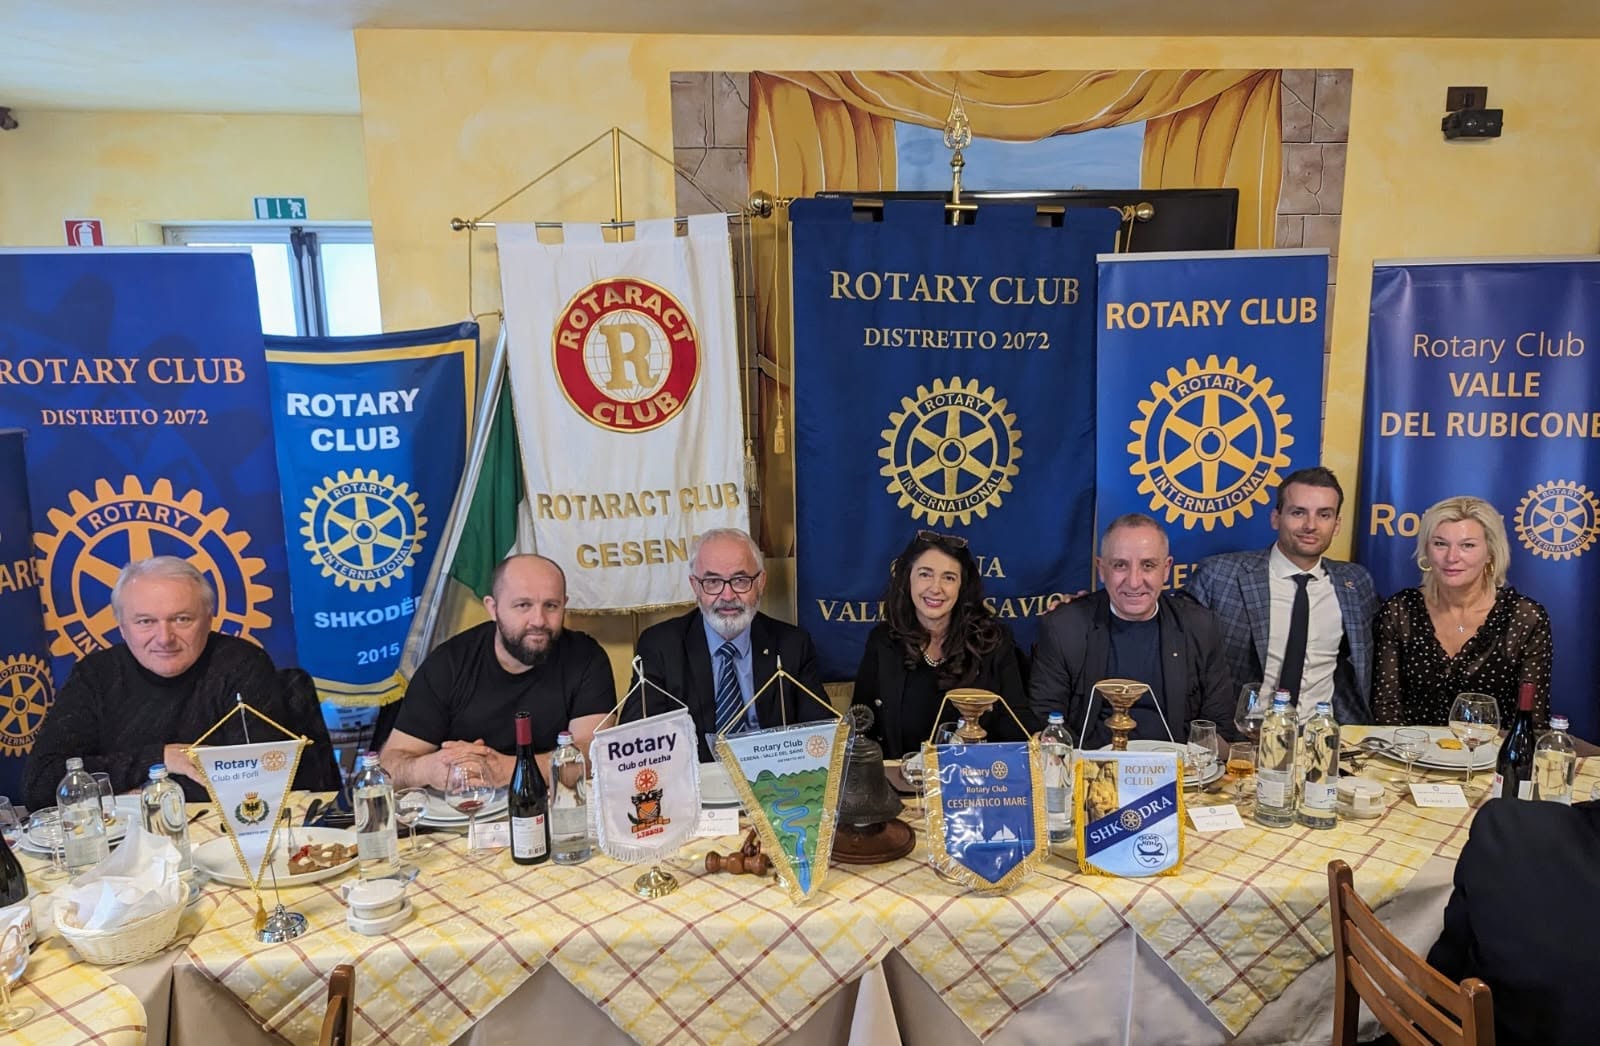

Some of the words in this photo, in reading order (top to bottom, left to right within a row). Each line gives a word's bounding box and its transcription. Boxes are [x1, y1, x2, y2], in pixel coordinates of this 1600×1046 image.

[830, 270, 983, 304] ROTARY
[989, 276, 1081, 306] CLUB
[558, 284, 694, 350] ROTARACT
[1105, 299, 1232, 330] ROTARY
[1240, 298, 1318, 325] CLUB
[864, 327, 997, 350] DISTRETTO
[1001, 331, 1050, 350] 2072
[1413, 334, 1506, 363] Rotary
[1516, 331, 1585, 358] Club
[0, 357, 141, 385] ROTARY
[147, 357, 246, 385] CLUB
[1177, 375, 1247, 398] ROTARY
[1449, 372, 1541, 398] VALLE
[287, 388, 420, 418] ROTARY
[592, 391, 680, 425] CLUB
[924, 394, 985, 412] ROTARY
[41, 409, 158, 426] DISTRETTO
[163, 409, 209, 426] 2072
[1380, 411, 1436, 437] DEL
[310, 425, 401, 452] CLUB
[332, 483, 388, 499] ROTARY
[536, 489, 671, 521] ROTARACT
[679, 482, 741, 515] CLUB
[901, 475, 1003, 512] INTERNATIONAL
[1152, 465, 1271, 513] INTERNATIONAL
[1541, 488, 1580, 498] ROTARY
[87, 502, 190, 531] ROTARY
[322, 542, 413, 581] INTERNATIONAL
[576, 534, 702, 570] CESEN
[357, 642, 401, 665] 2015
[0, 665, 33, 680] OTARY
[607, 732, 677, 761] Rotary
[753, 743, 781, 754] Rotary
[783, 739, 803, 749] Club
[214, 758, 259, 771] Rotary
[618, 761, 636, 773] Club
[638, 758, 647, 768] of
[649, 754, 672, 766] Lezha
[1124, 765, 1168, 775] ROTARY
[211, 774, 231, 783] Club
[232, 772, 240, 780] di
[966, 786, 991, 794] Rotary
[991, 785, 1008, 793] Club
[1124, 776, 1154, 786] CLUB
[947, 797, 1001, 809] CESENATICO
[1003, 796, 1028, 807] MARE
